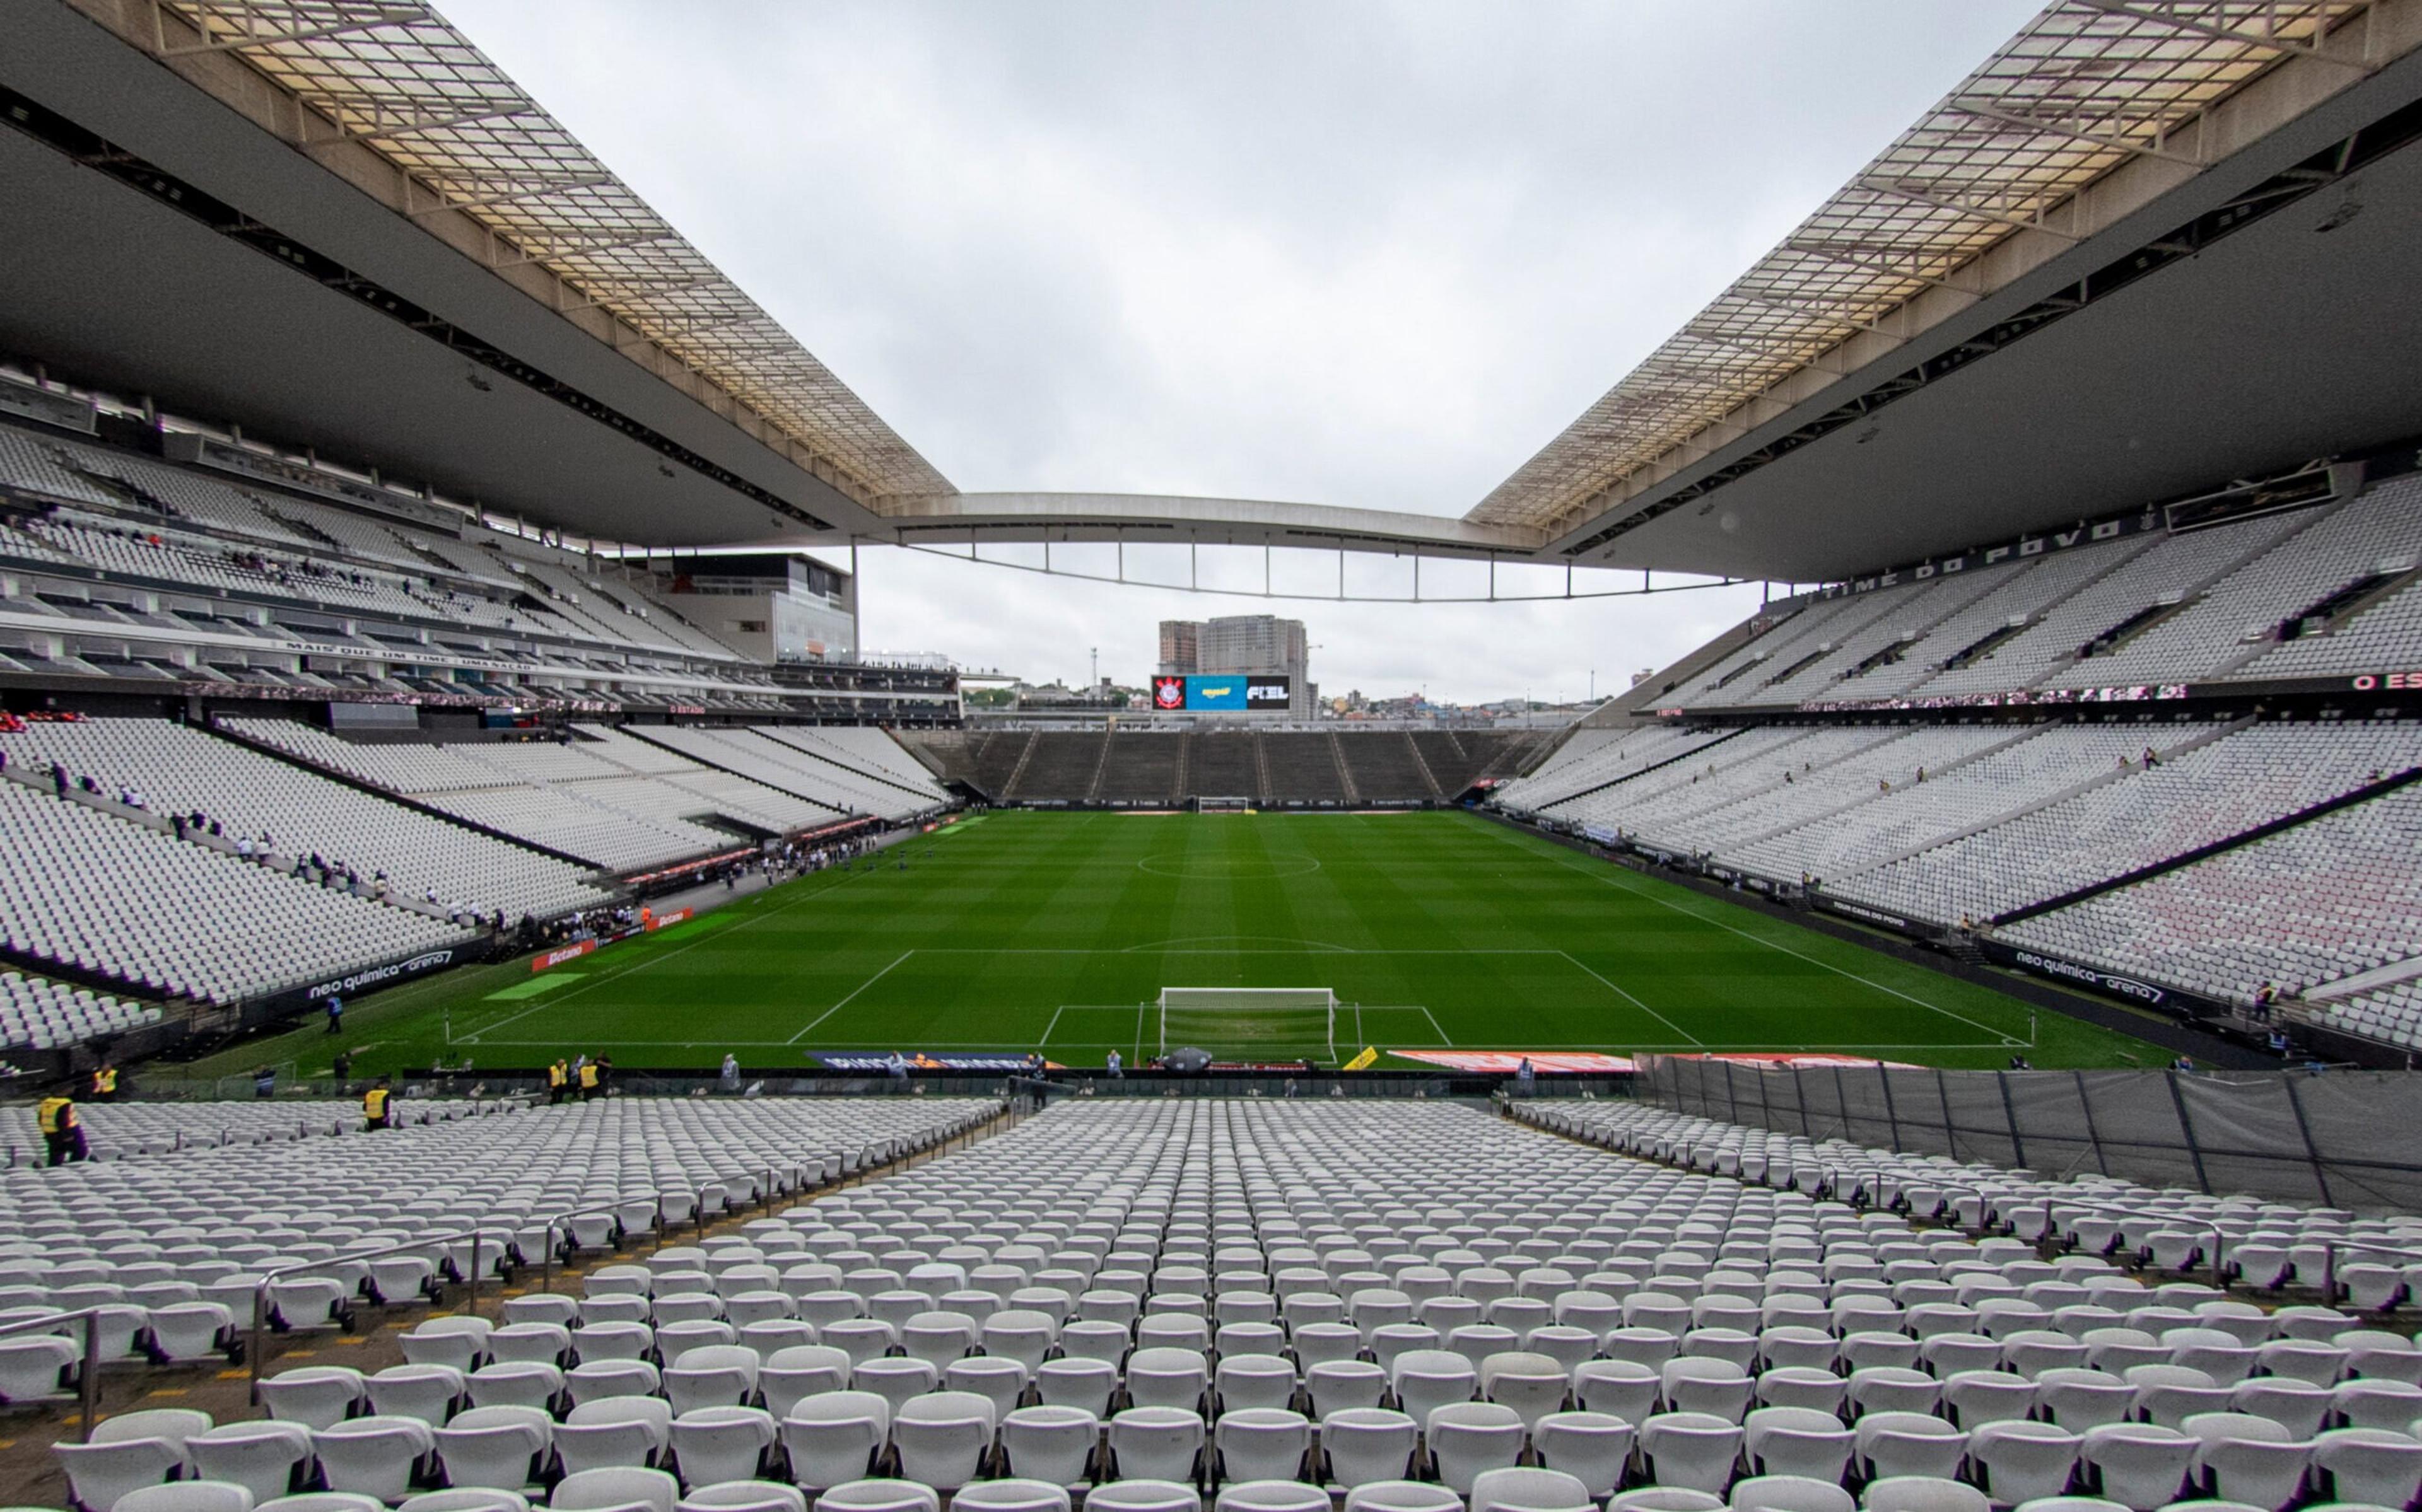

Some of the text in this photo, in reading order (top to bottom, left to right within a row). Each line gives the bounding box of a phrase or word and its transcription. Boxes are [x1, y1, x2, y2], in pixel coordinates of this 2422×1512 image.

[1916, 557, 1963, 579] DO
[1986, 520, 2121, 563] POVO
[286, 642, 333, 652] MAIS
[414, 654, 448, 663] TIME
[462, 659, 489, 667] UMA
[2352, 675, 2376, 690] O
[548, 946, 583, 965] Betano
[310, 953, 444, 999] neo química arena
[2016, 951, 2150, 999] neo química arena
